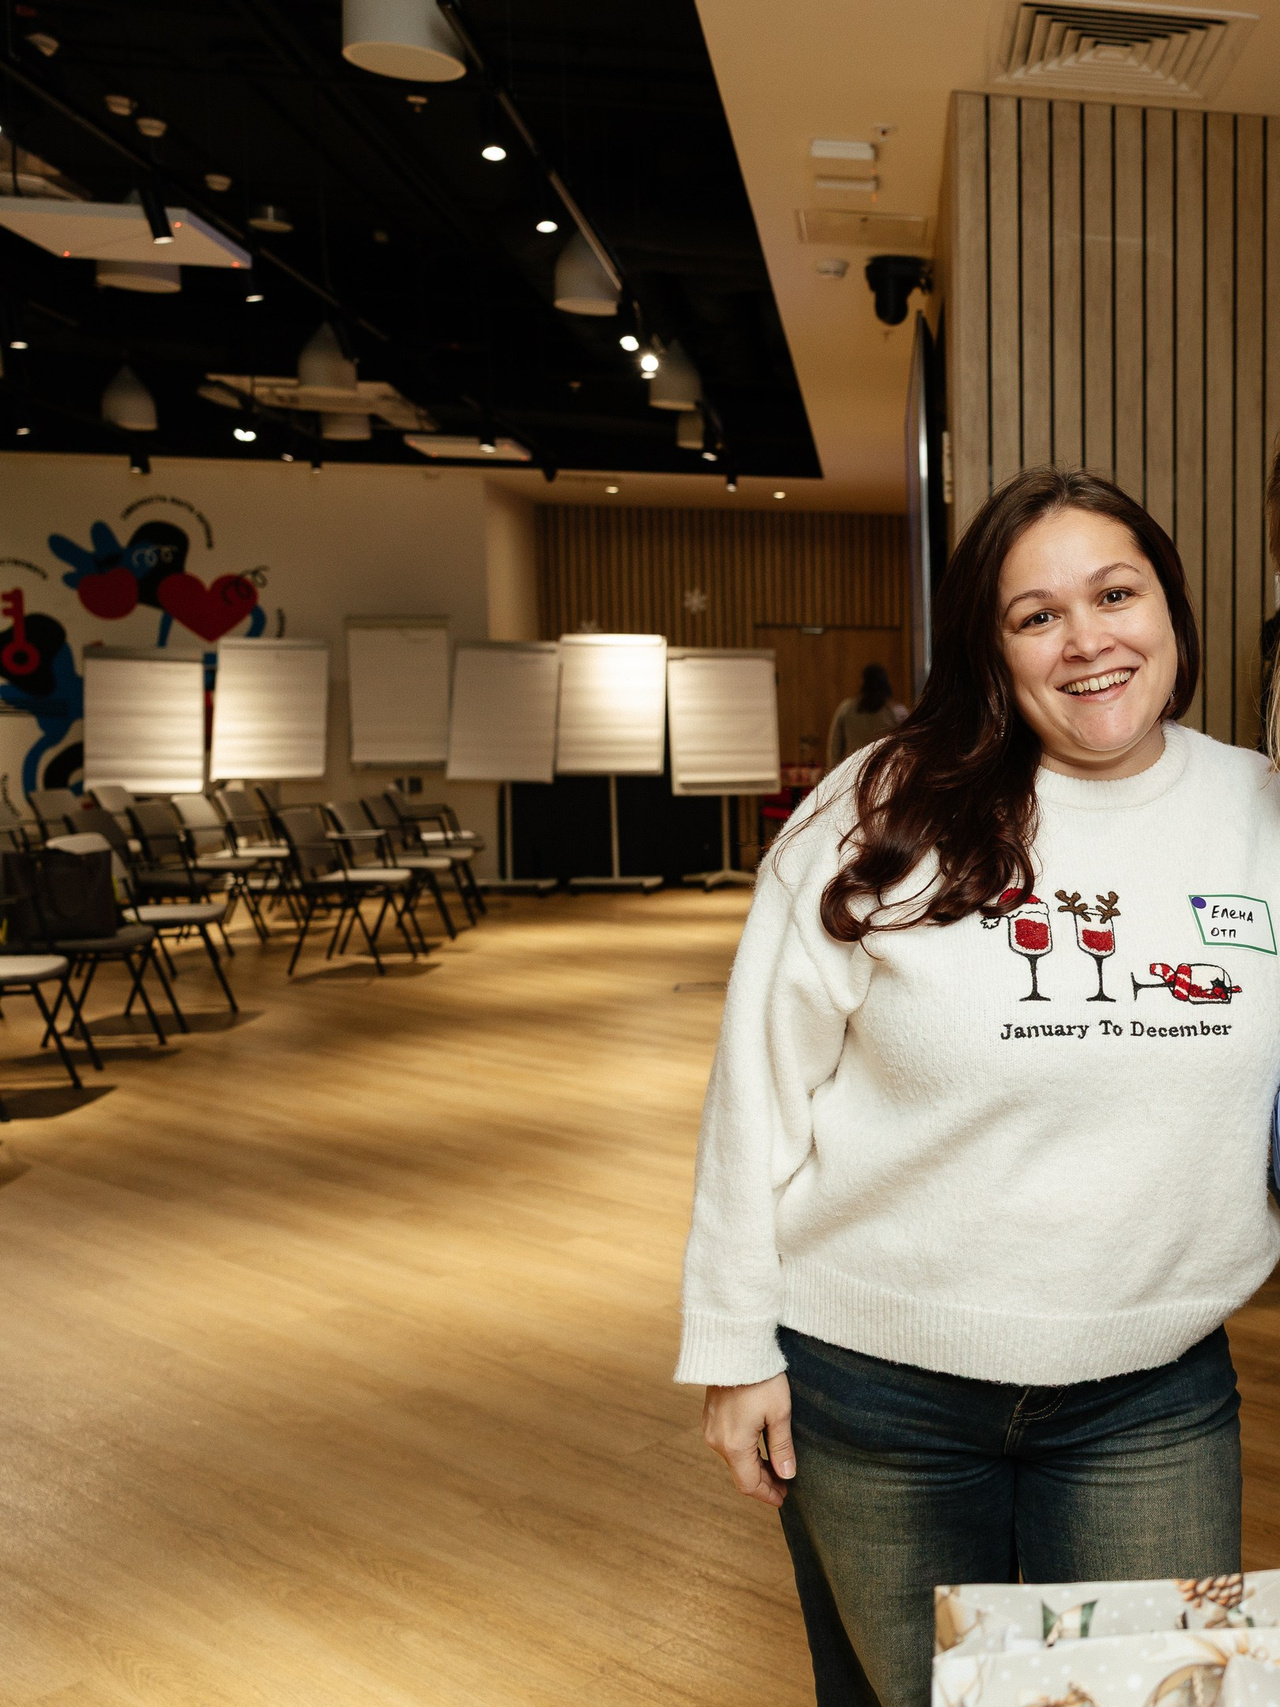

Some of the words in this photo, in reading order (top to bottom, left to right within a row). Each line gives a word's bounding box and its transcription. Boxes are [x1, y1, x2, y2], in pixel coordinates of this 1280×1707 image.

[1000, 1023, 1090, 1040] January
[1099, 1020, 1123, 1036] To
[1130, 1020, 1233, 1037] December
